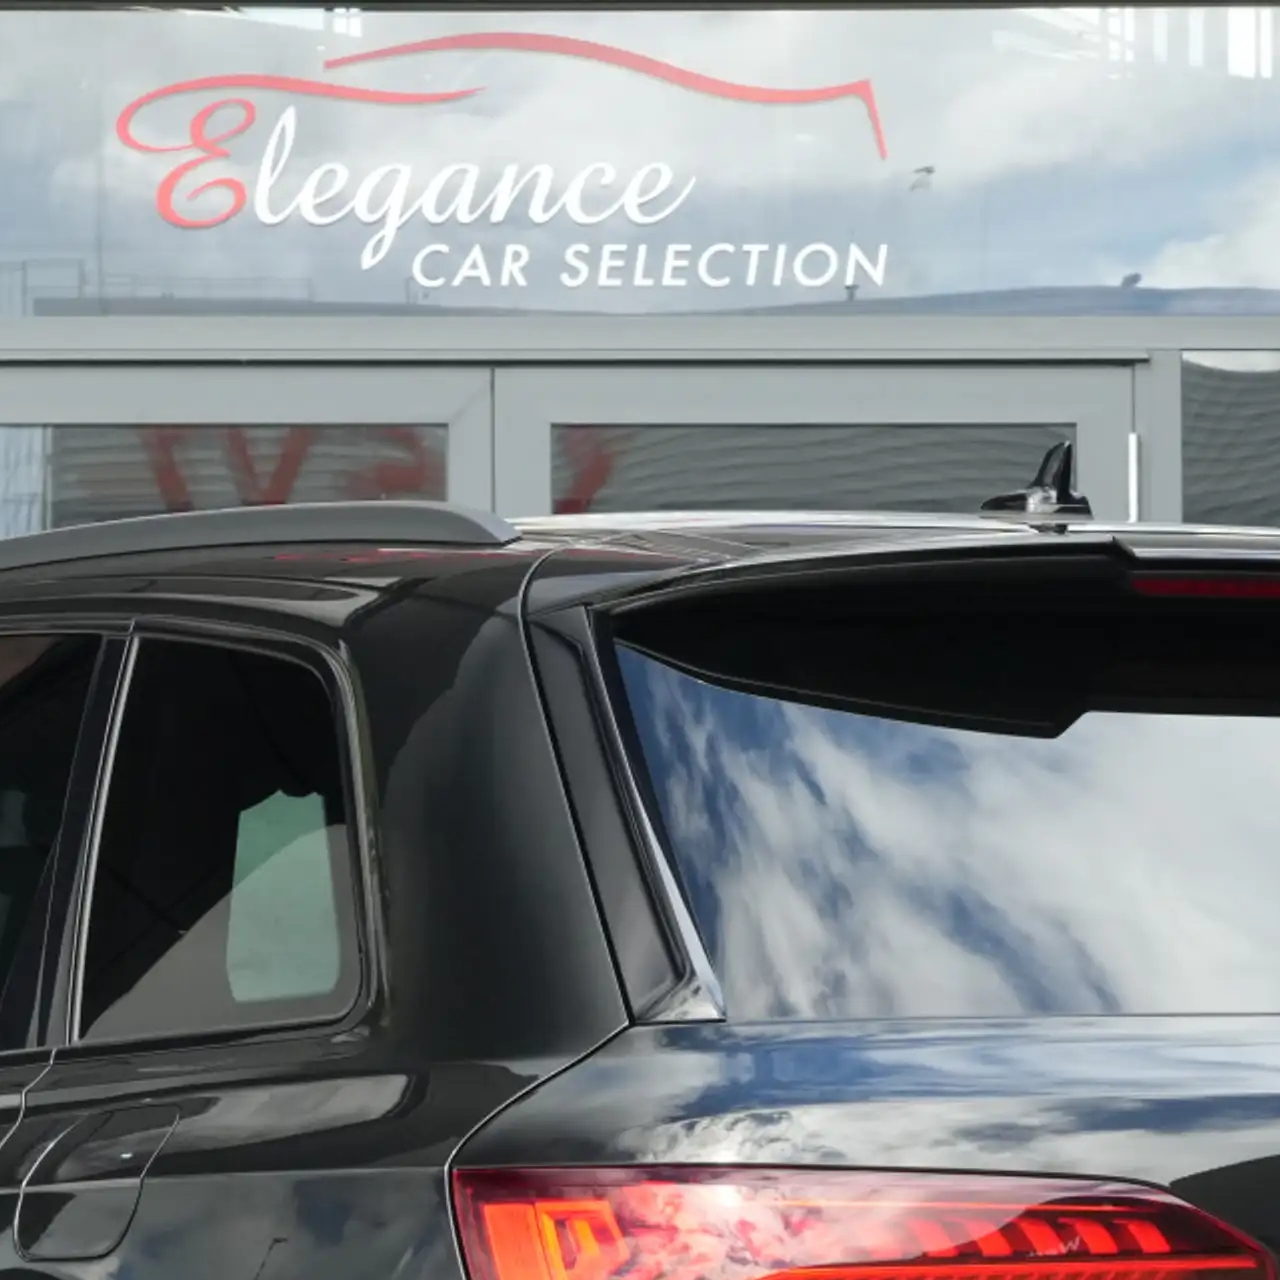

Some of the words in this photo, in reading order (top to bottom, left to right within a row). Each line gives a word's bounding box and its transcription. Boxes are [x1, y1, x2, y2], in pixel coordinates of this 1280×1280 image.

[117, 76, 696, 270] Elegance
[411, 243, 530, 287] CAR
[559, 243, 888, 288] SELECTION
